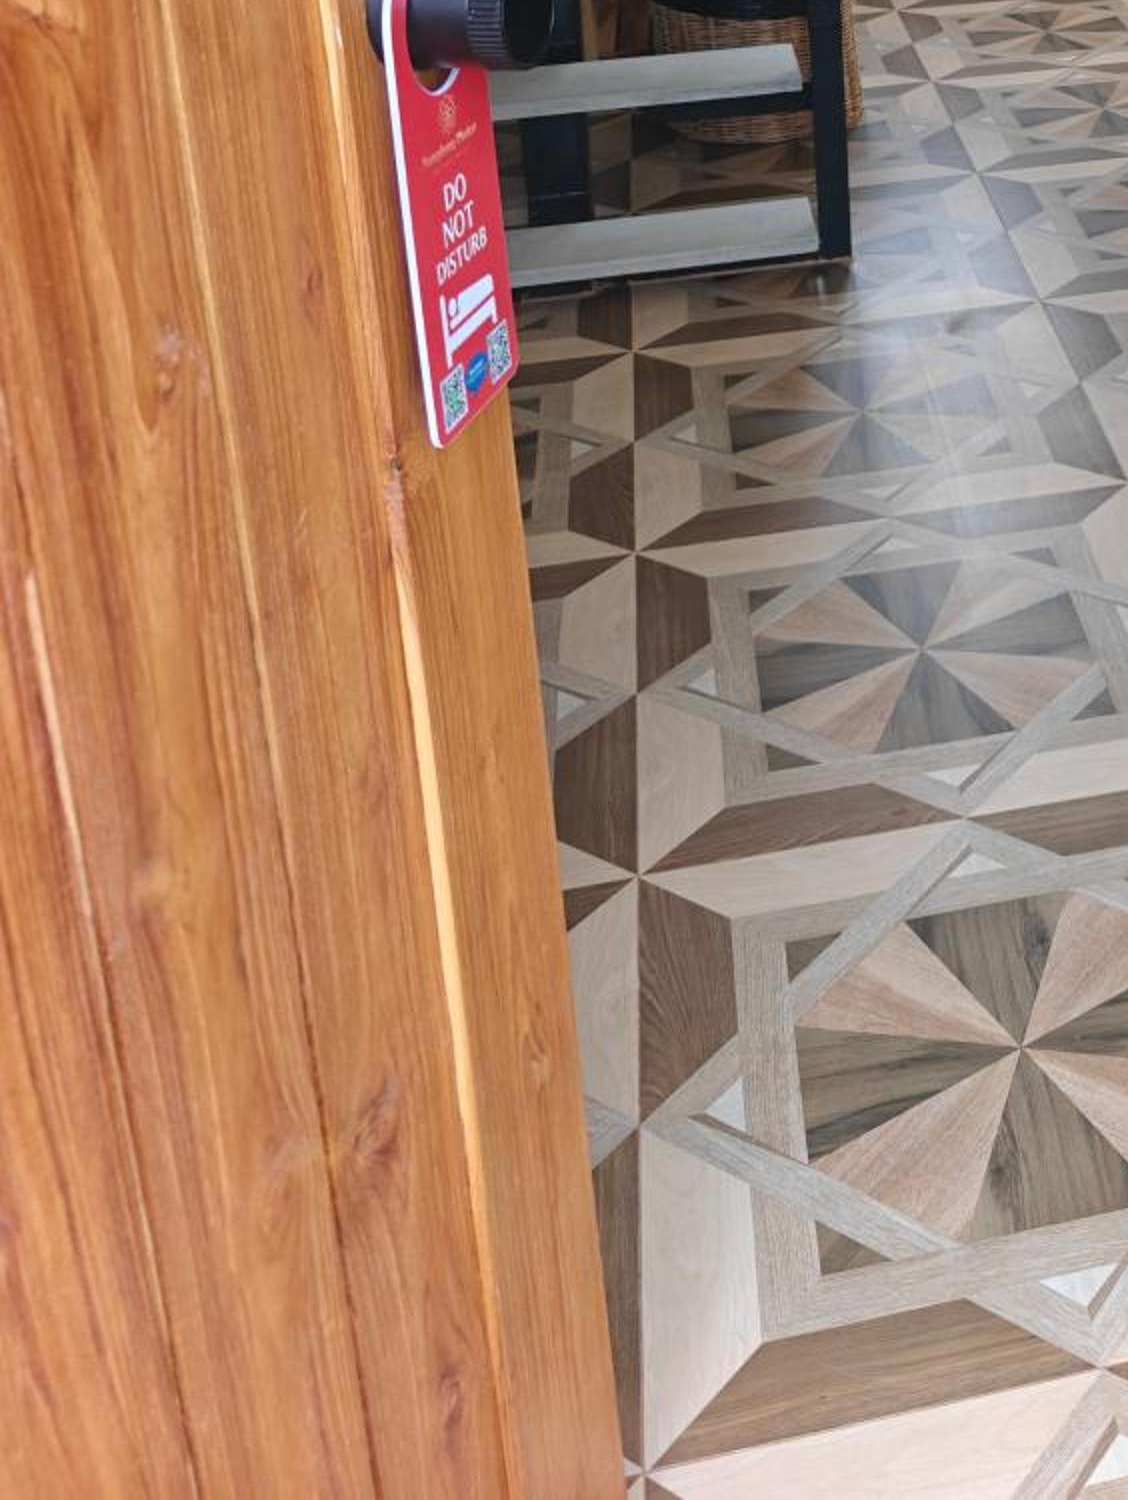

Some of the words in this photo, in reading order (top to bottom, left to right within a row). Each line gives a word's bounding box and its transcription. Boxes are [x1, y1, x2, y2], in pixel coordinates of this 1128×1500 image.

[443, 173, 467, 212] DO
[442, 200, 474, 249] NOT
[437, 226, 488, 286] DISTURB
